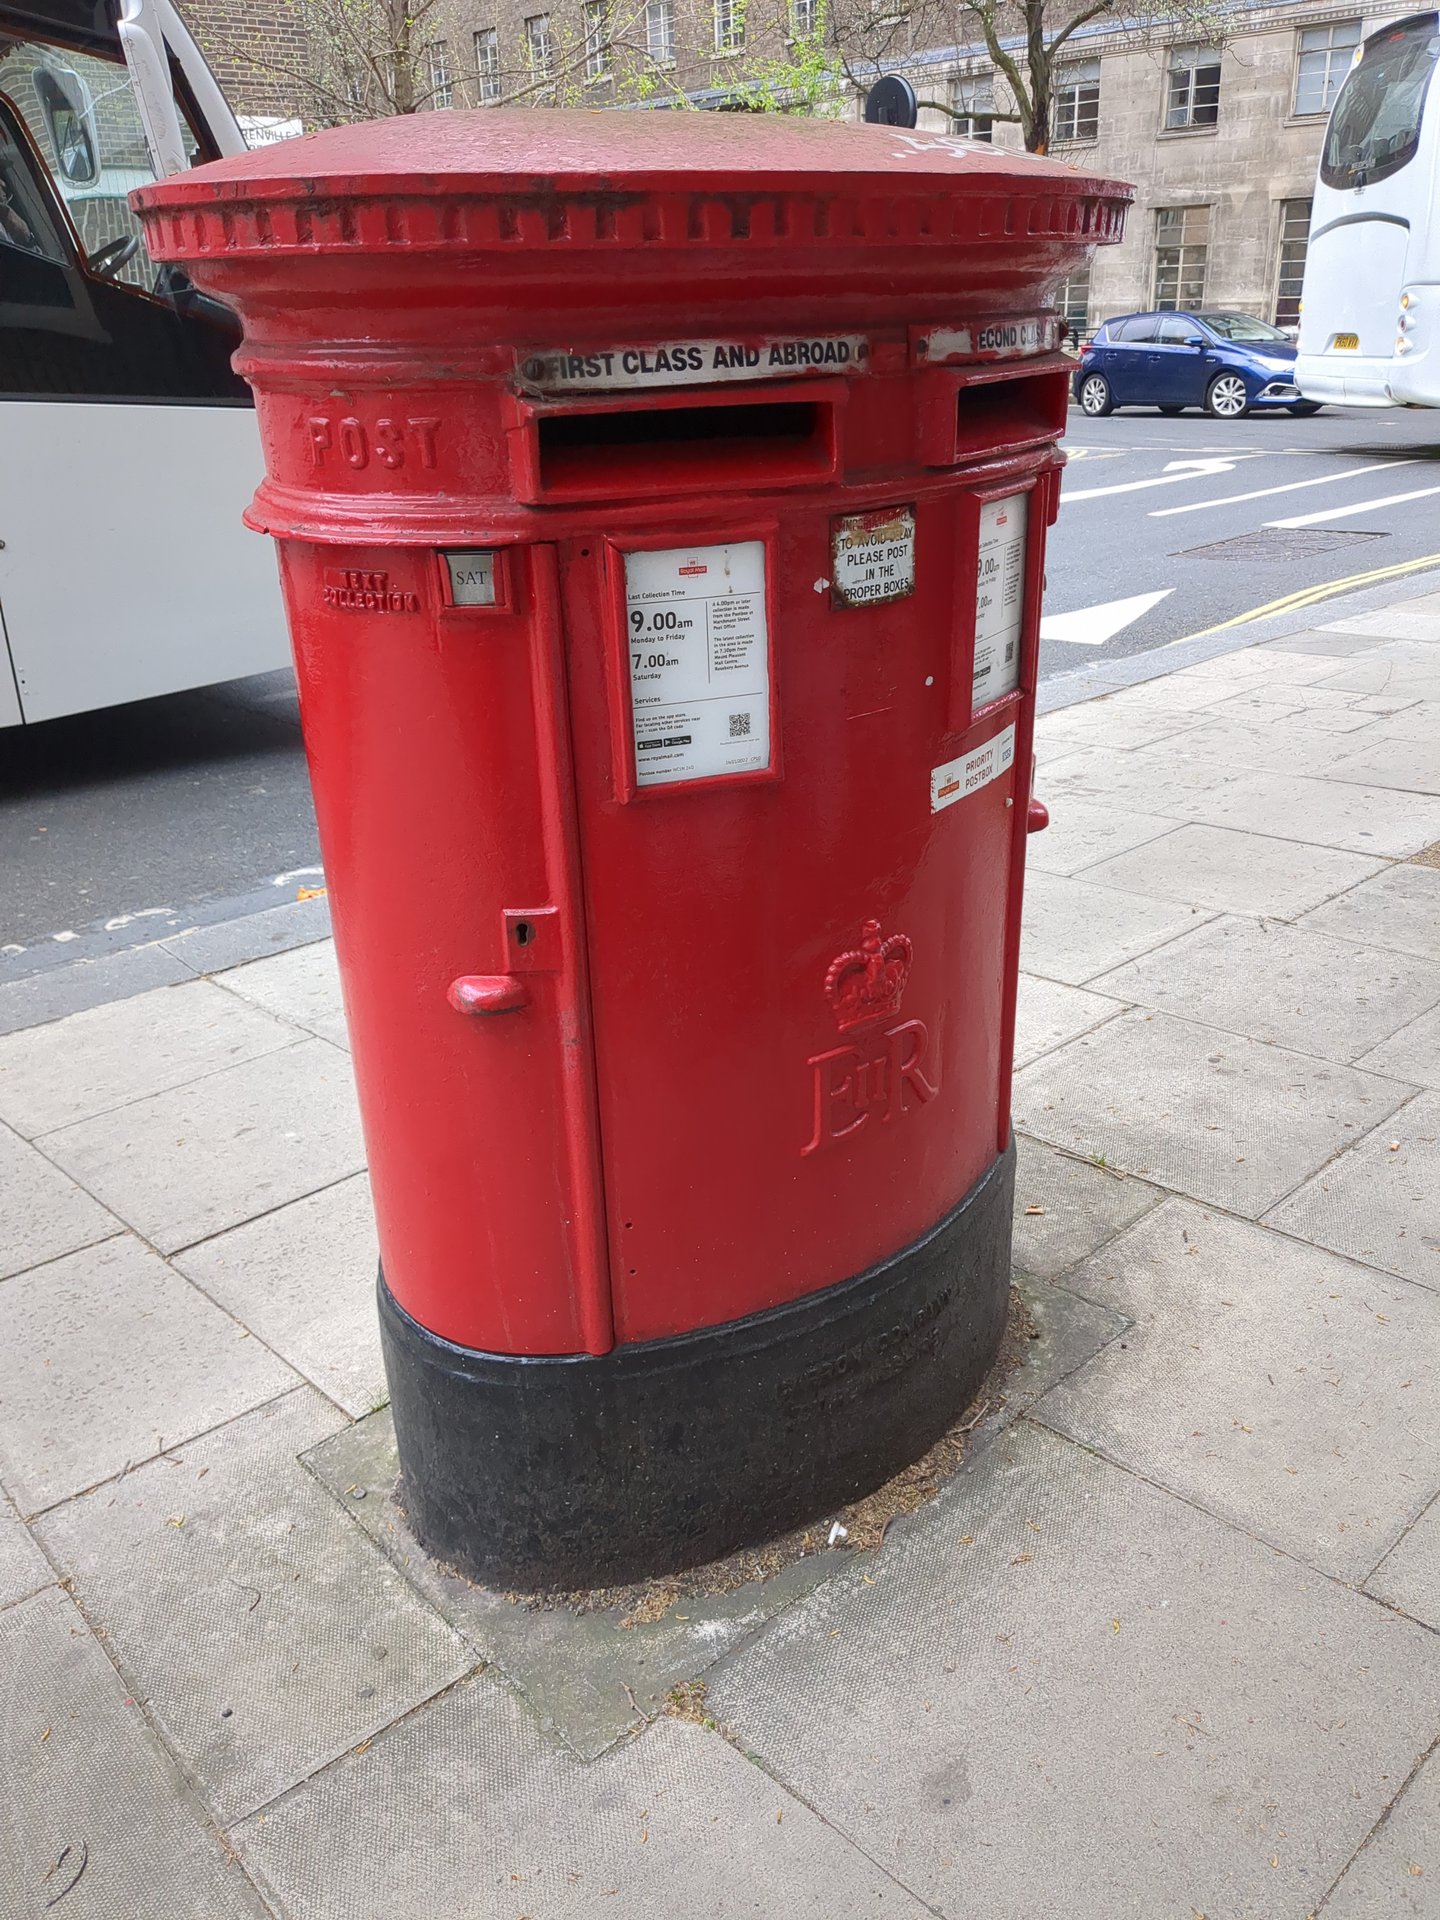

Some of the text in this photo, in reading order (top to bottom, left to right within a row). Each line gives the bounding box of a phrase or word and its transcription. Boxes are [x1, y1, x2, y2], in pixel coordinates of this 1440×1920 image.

[242, 129, 291, 141] RENVILLE
[979, 323, 1047, 349] ECOND CLAS
[550, 341, 850, 380] FIRST CLASS AND ABROAD
[307, 416, 442, 470] POST
[840, 537, 853, 551] TO
[847, 544, 908, 567] PLEASE POST
[456, 570, 487, 586] SAT
[865, 564, 894, 580] IN THE
[642, 591, 670, 599] Collection
[671, 589, 685, 597] Time
[843, 577, 909, 600] PROPER BOXES
[323, 586, 420, 614] COLLECTION
[630, 610, 693, 632] 9.00am
[630, 633, 685, 645] Monday to Friday
[632, 653, 679, 669] 7.00am
[633, 672, 661, 681] Saturday
[634, 696, 661, 705] Services
[965, 748, 994, 774] PRIORITY
[965, 764, 993, 790] POSTBOX
